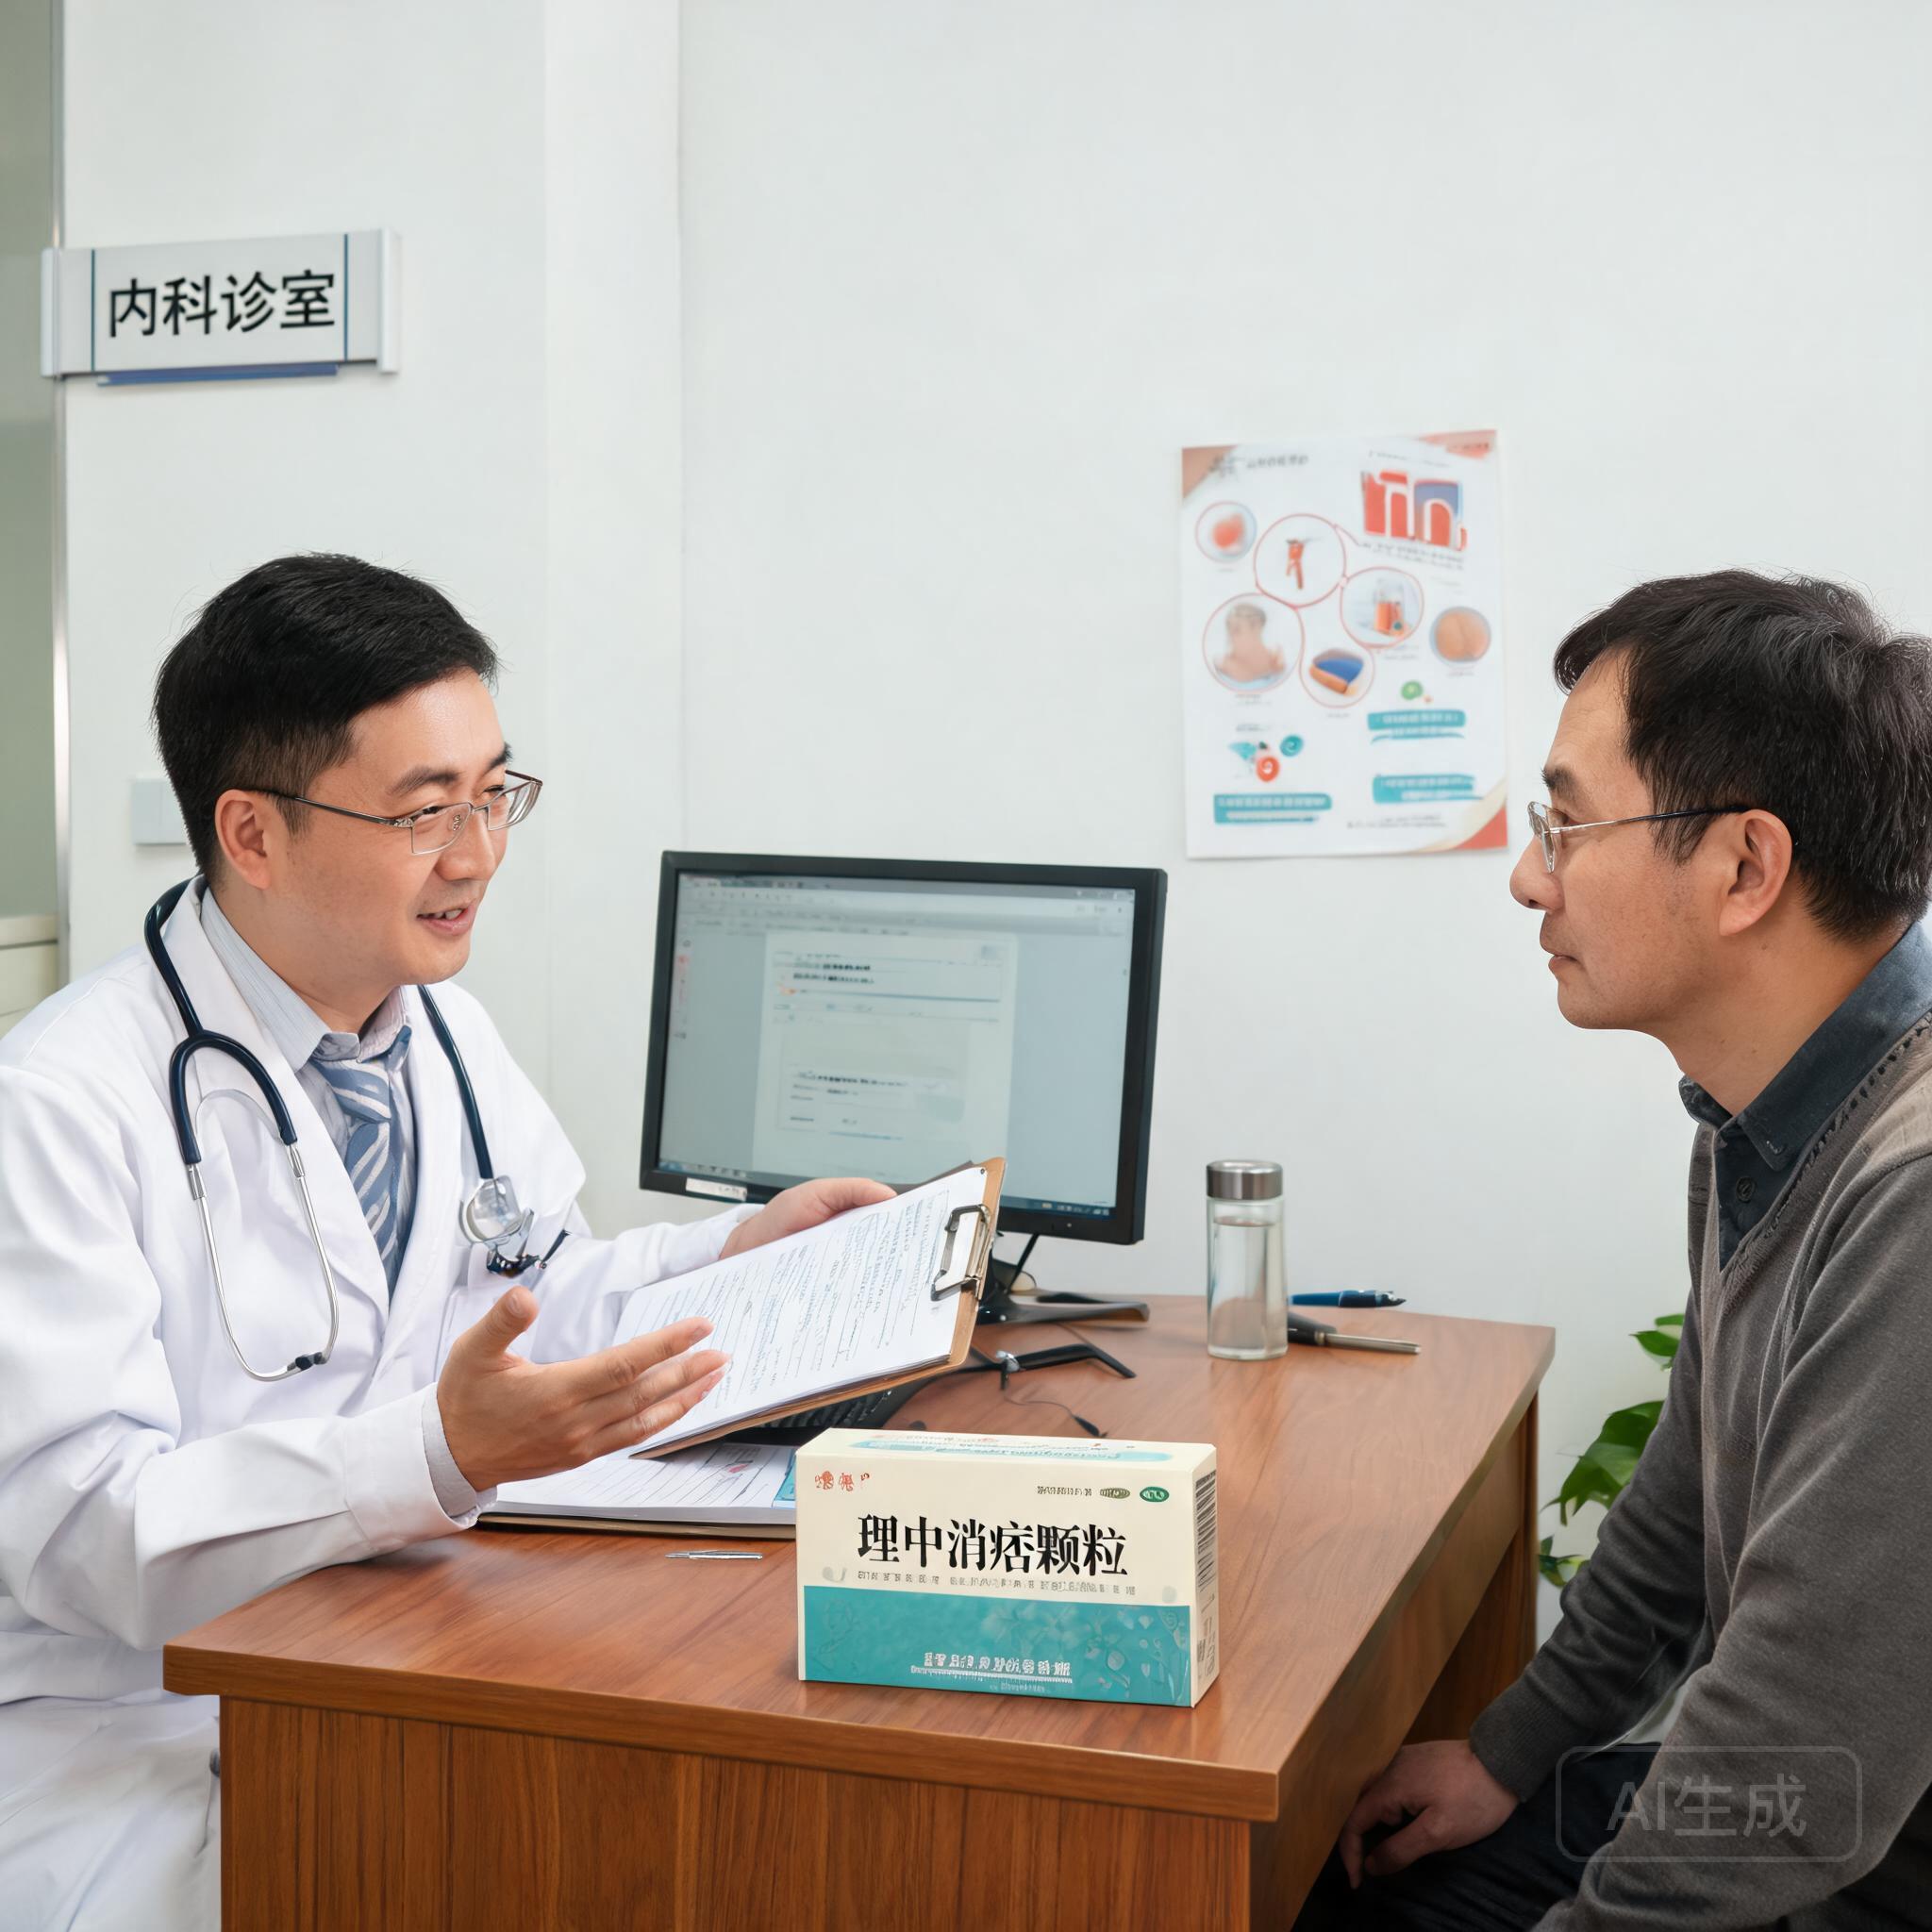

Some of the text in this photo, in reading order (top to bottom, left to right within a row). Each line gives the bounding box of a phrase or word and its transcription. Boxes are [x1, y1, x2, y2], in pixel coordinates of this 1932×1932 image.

[108, 269, 336, 338] 内科诊室
[857, 1512, 1129, 1576] 理中消痞颗粒
